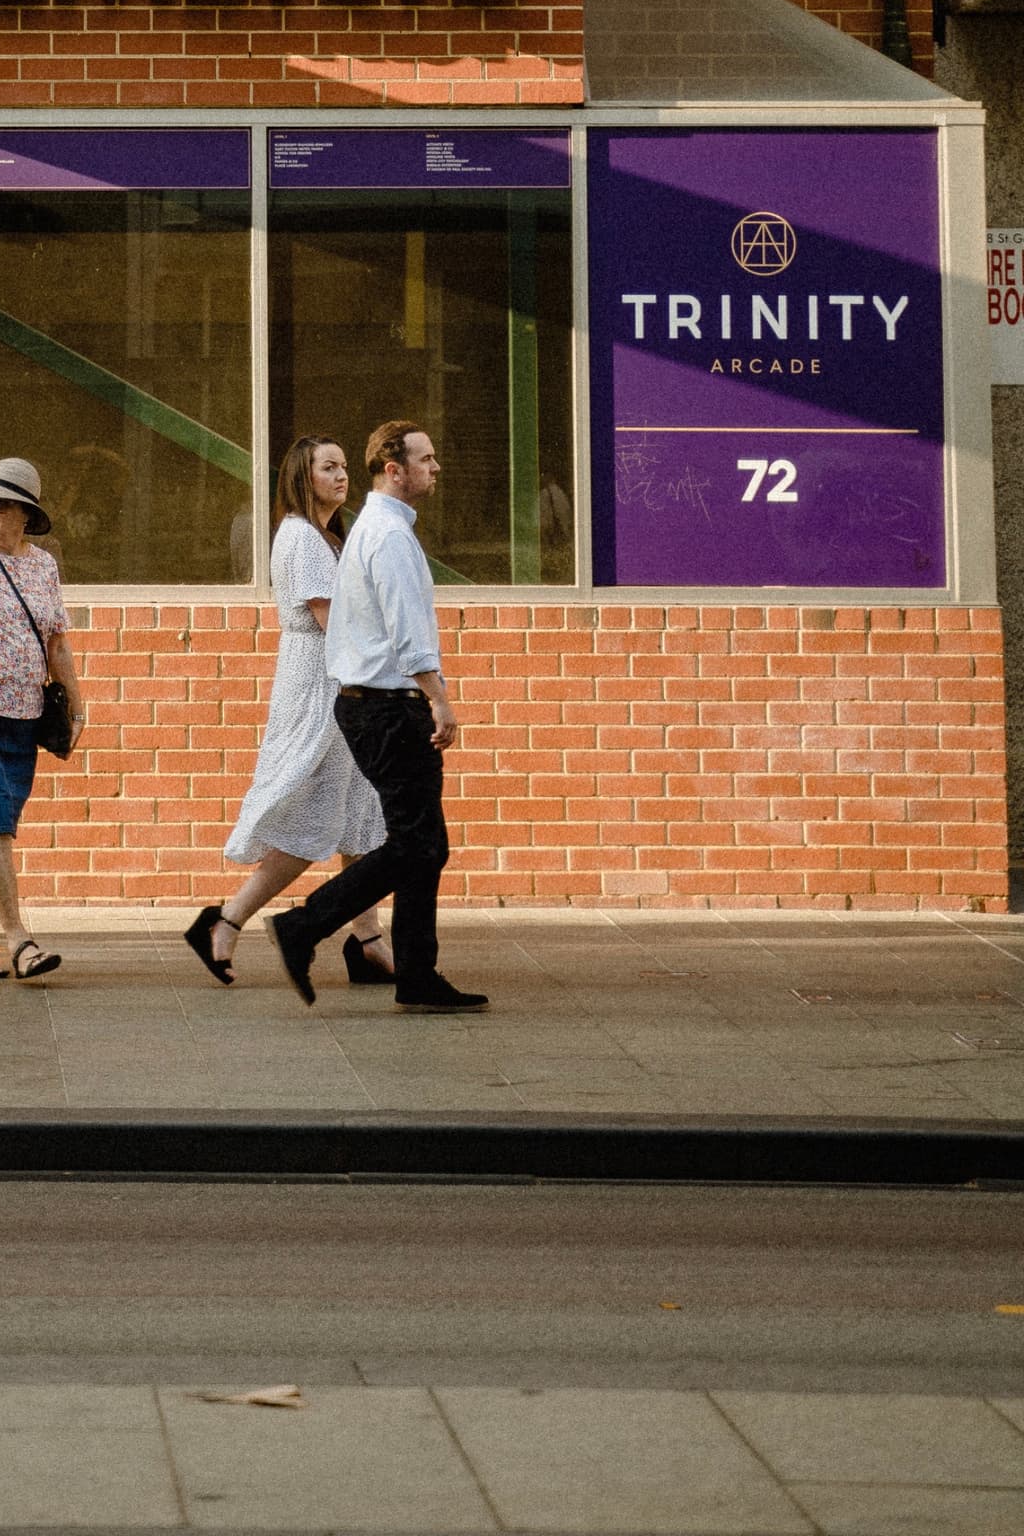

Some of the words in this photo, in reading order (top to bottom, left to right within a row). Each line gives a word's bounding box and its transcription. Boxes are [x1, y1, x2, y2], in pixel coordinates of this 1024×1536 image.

[621, 294, 910, 341] TRINITY
[988, 287, 1024, 325] BO
[710, 358, 822, 374] ARCADE
[736, 459, 799, 503] 72
